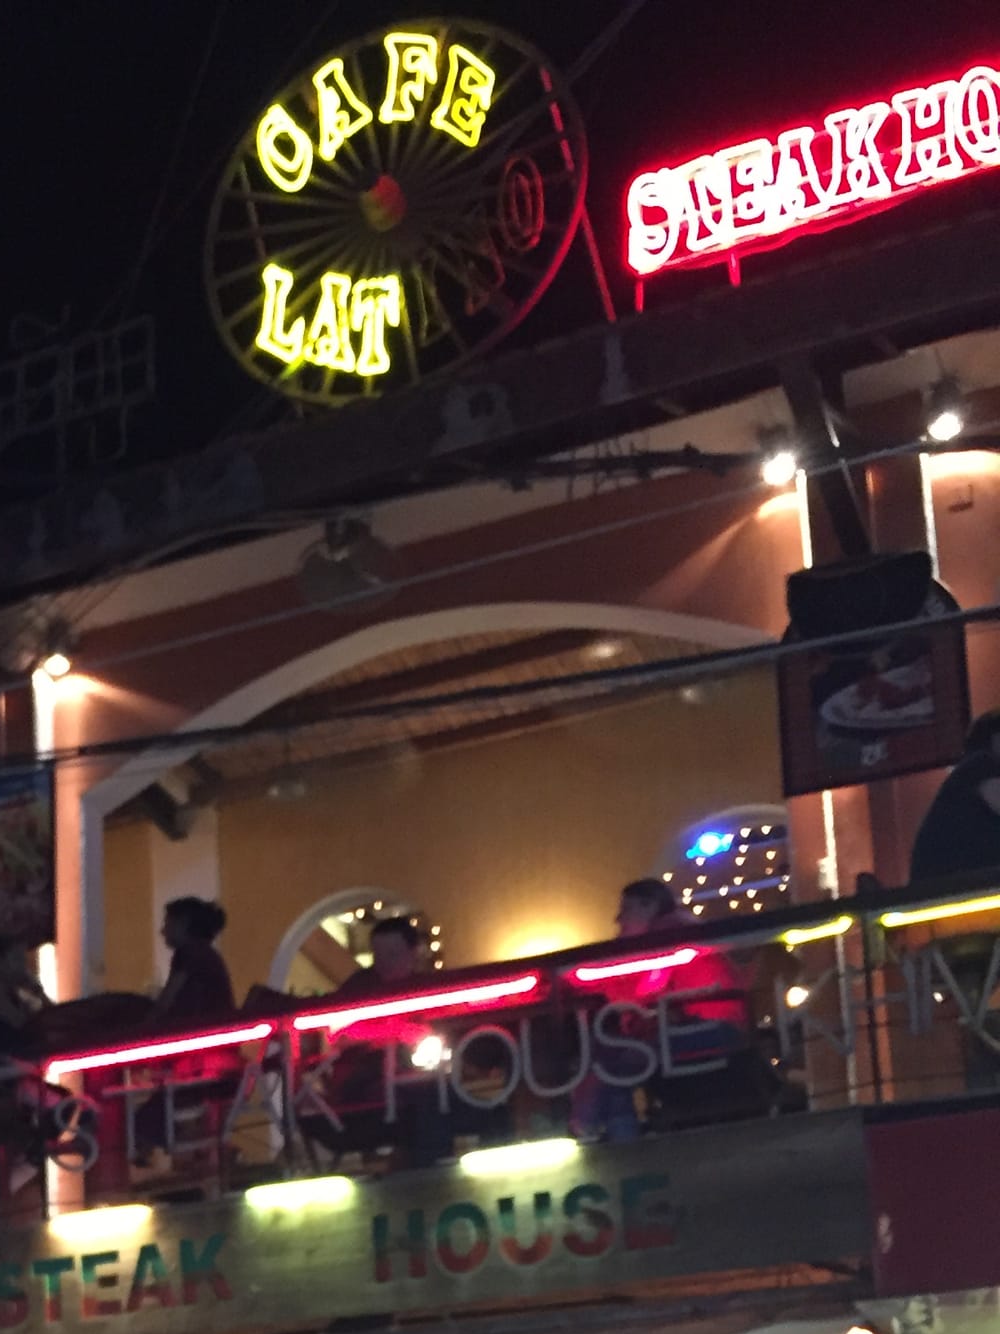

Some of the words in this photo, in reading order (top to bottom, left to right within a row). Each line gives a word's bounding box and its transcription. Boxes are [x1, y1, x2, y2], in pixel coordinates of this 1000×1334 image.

[52, 1028, 346, 1172] STEAK
[384, 982, 729, 1124] HOUSE
[373, 1173, 679, 1284] HOUSE
